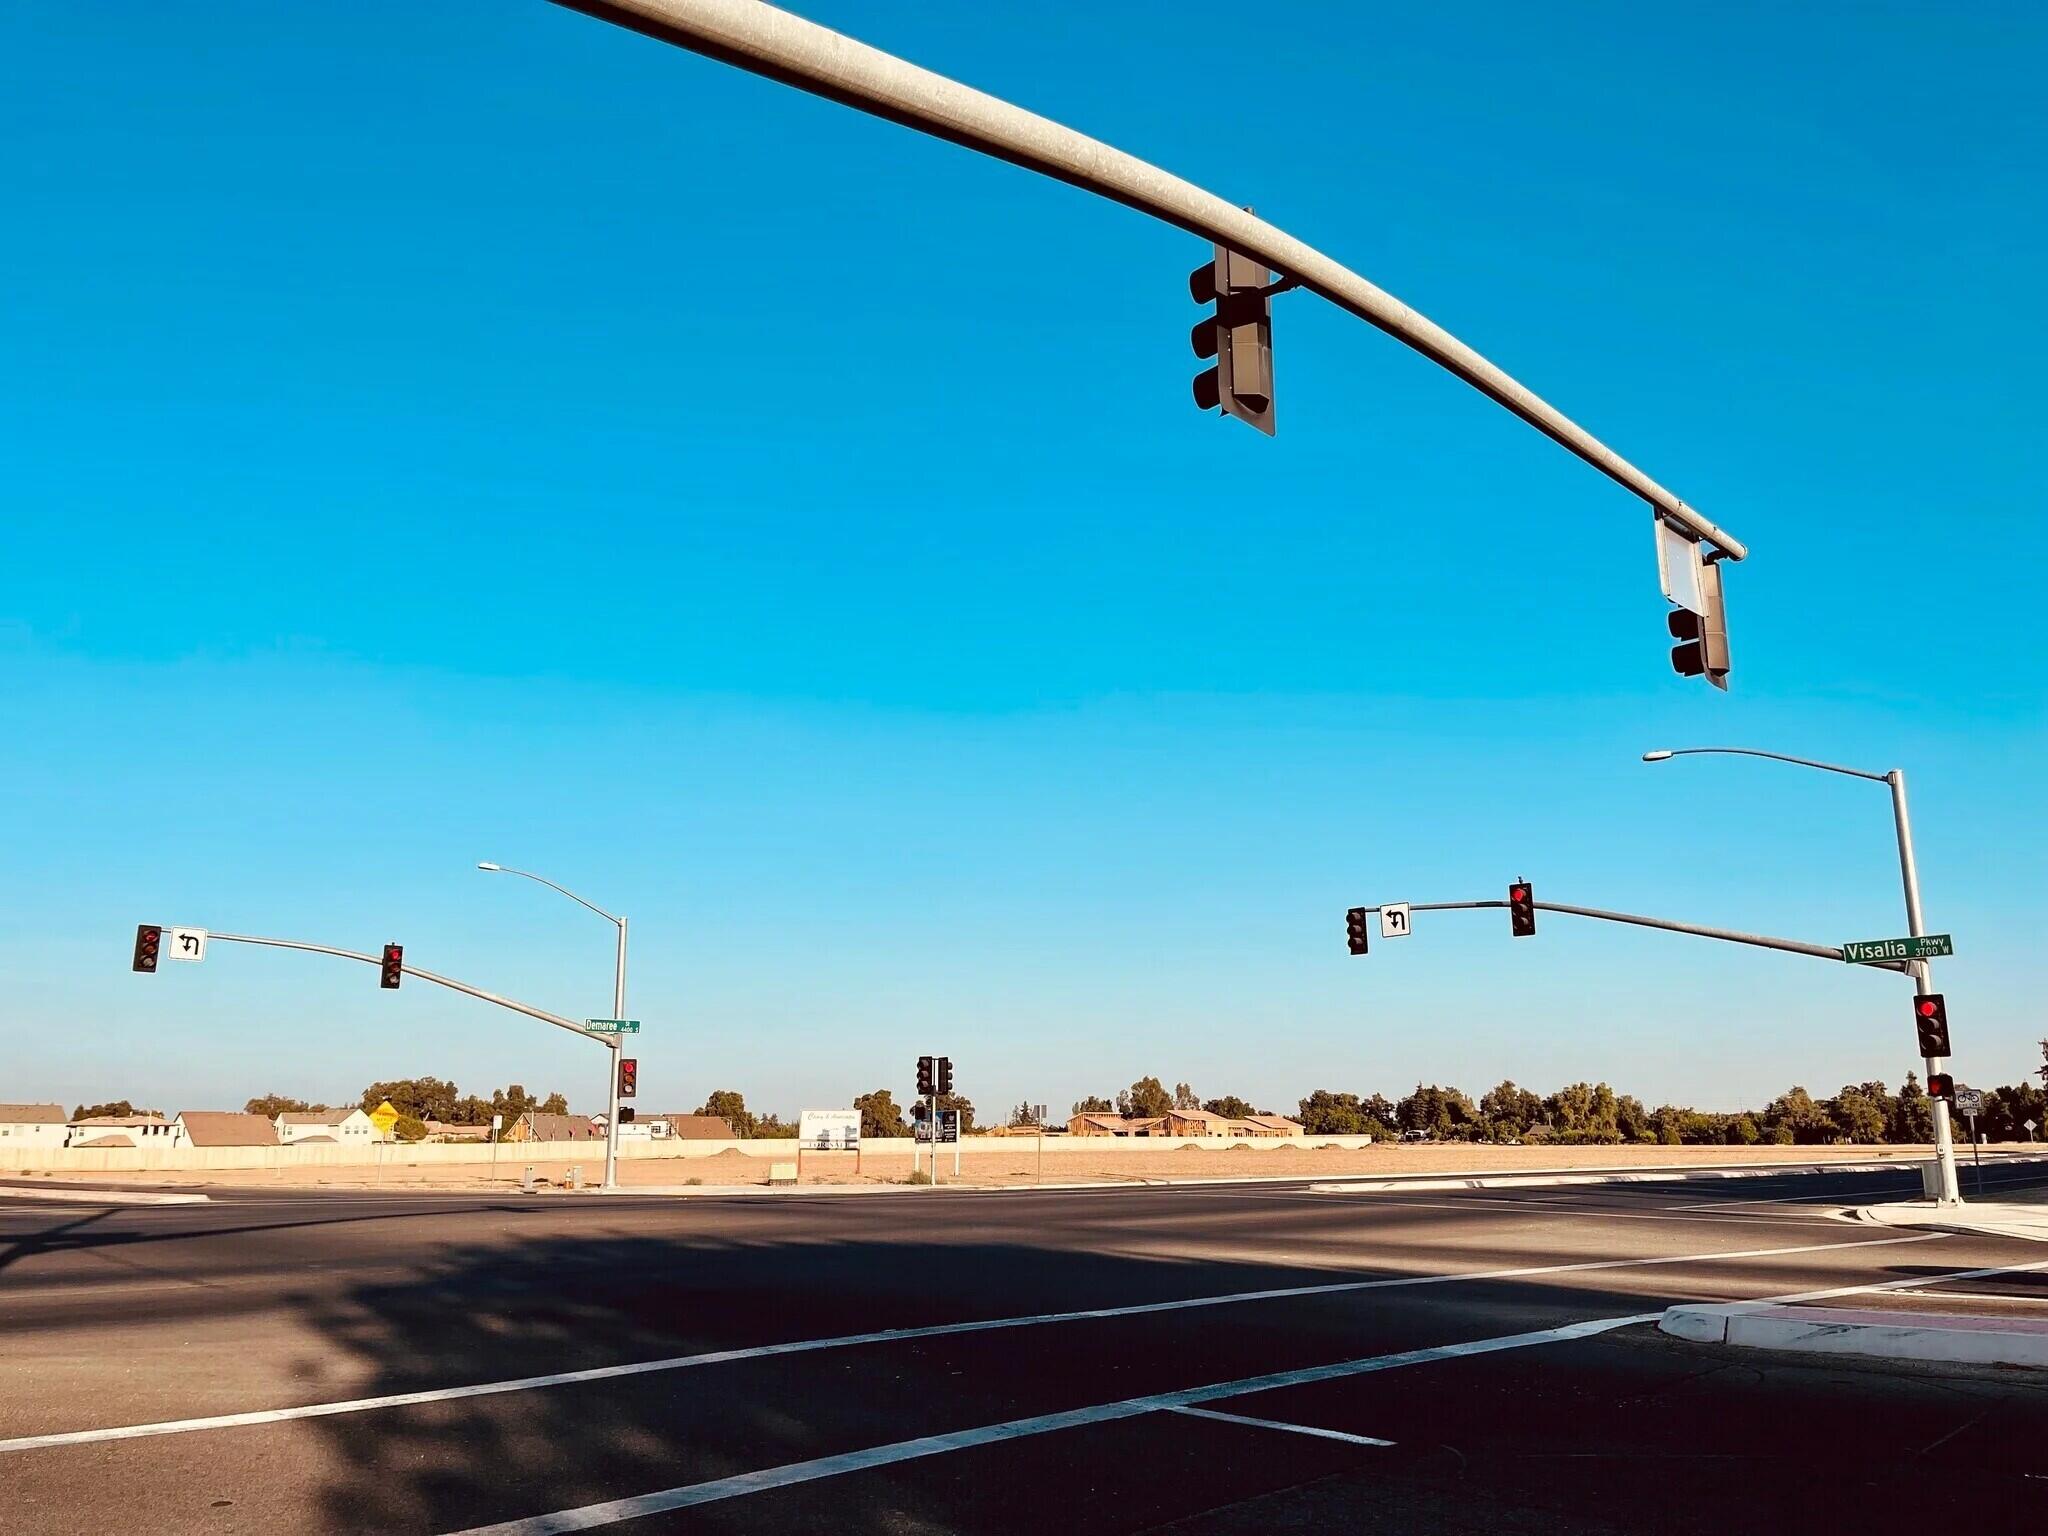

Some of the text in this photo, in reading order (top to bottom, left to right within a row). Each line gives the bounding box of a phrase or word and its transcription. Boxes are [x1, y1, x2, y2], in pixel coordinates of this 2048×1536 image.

[1920, 938, 1944, 947] Pkwy
[1847, 941, 1907, 960] Visalia
[1915, 946, 1949, 957] 3700 W
[586, 1020, 618, 1031] Demaree
